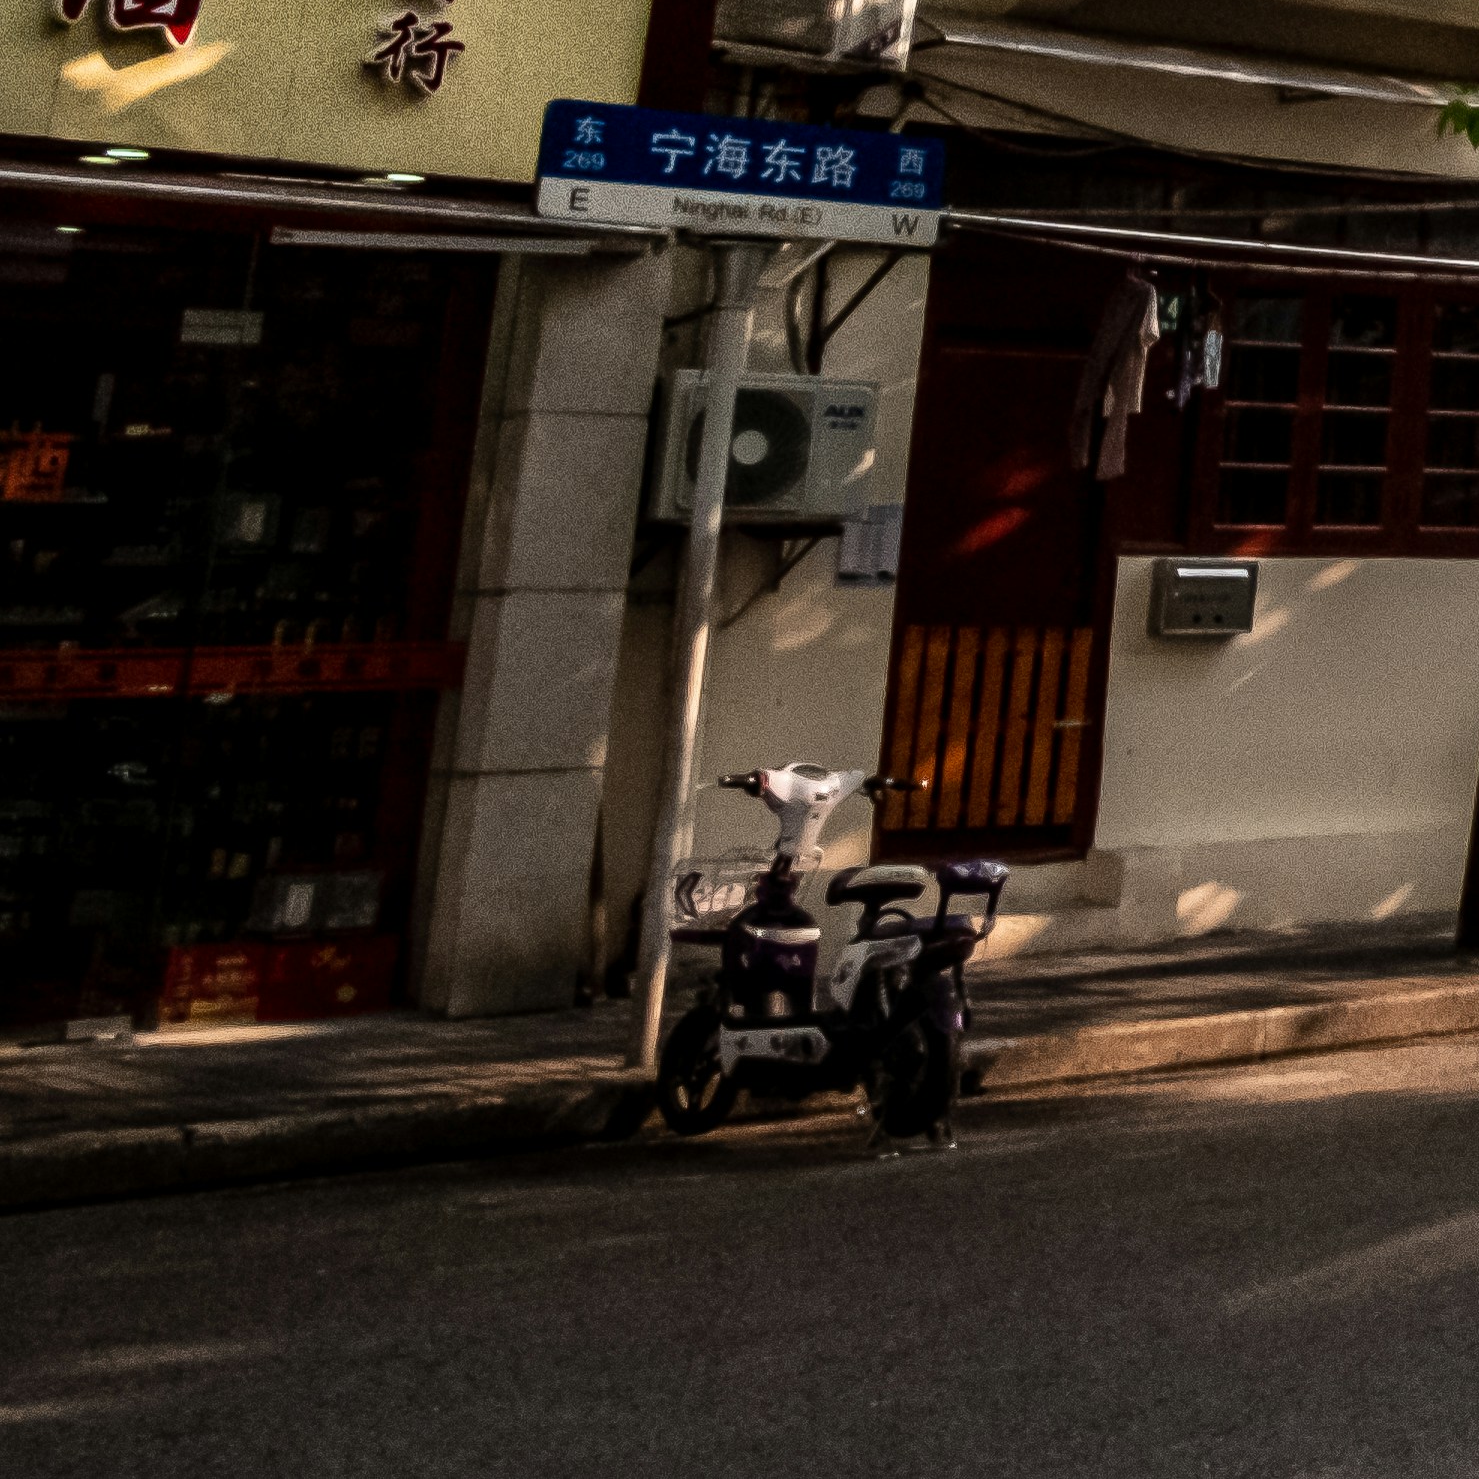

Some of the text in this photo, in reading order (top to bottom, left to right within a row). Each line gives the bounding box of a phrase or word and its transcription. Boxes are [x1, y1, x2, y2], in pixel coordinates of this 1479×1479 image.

[575, 115, 607, 146] 东
[562, 149, 607, 172] 269
[650, 128, 858, 190] 宁海东路
[898, 146, 927, 177] 西
[569, 188, 590, 212] E
[672, 196, 750, 222] Ninghai
[891, 214, 920, 236] W
